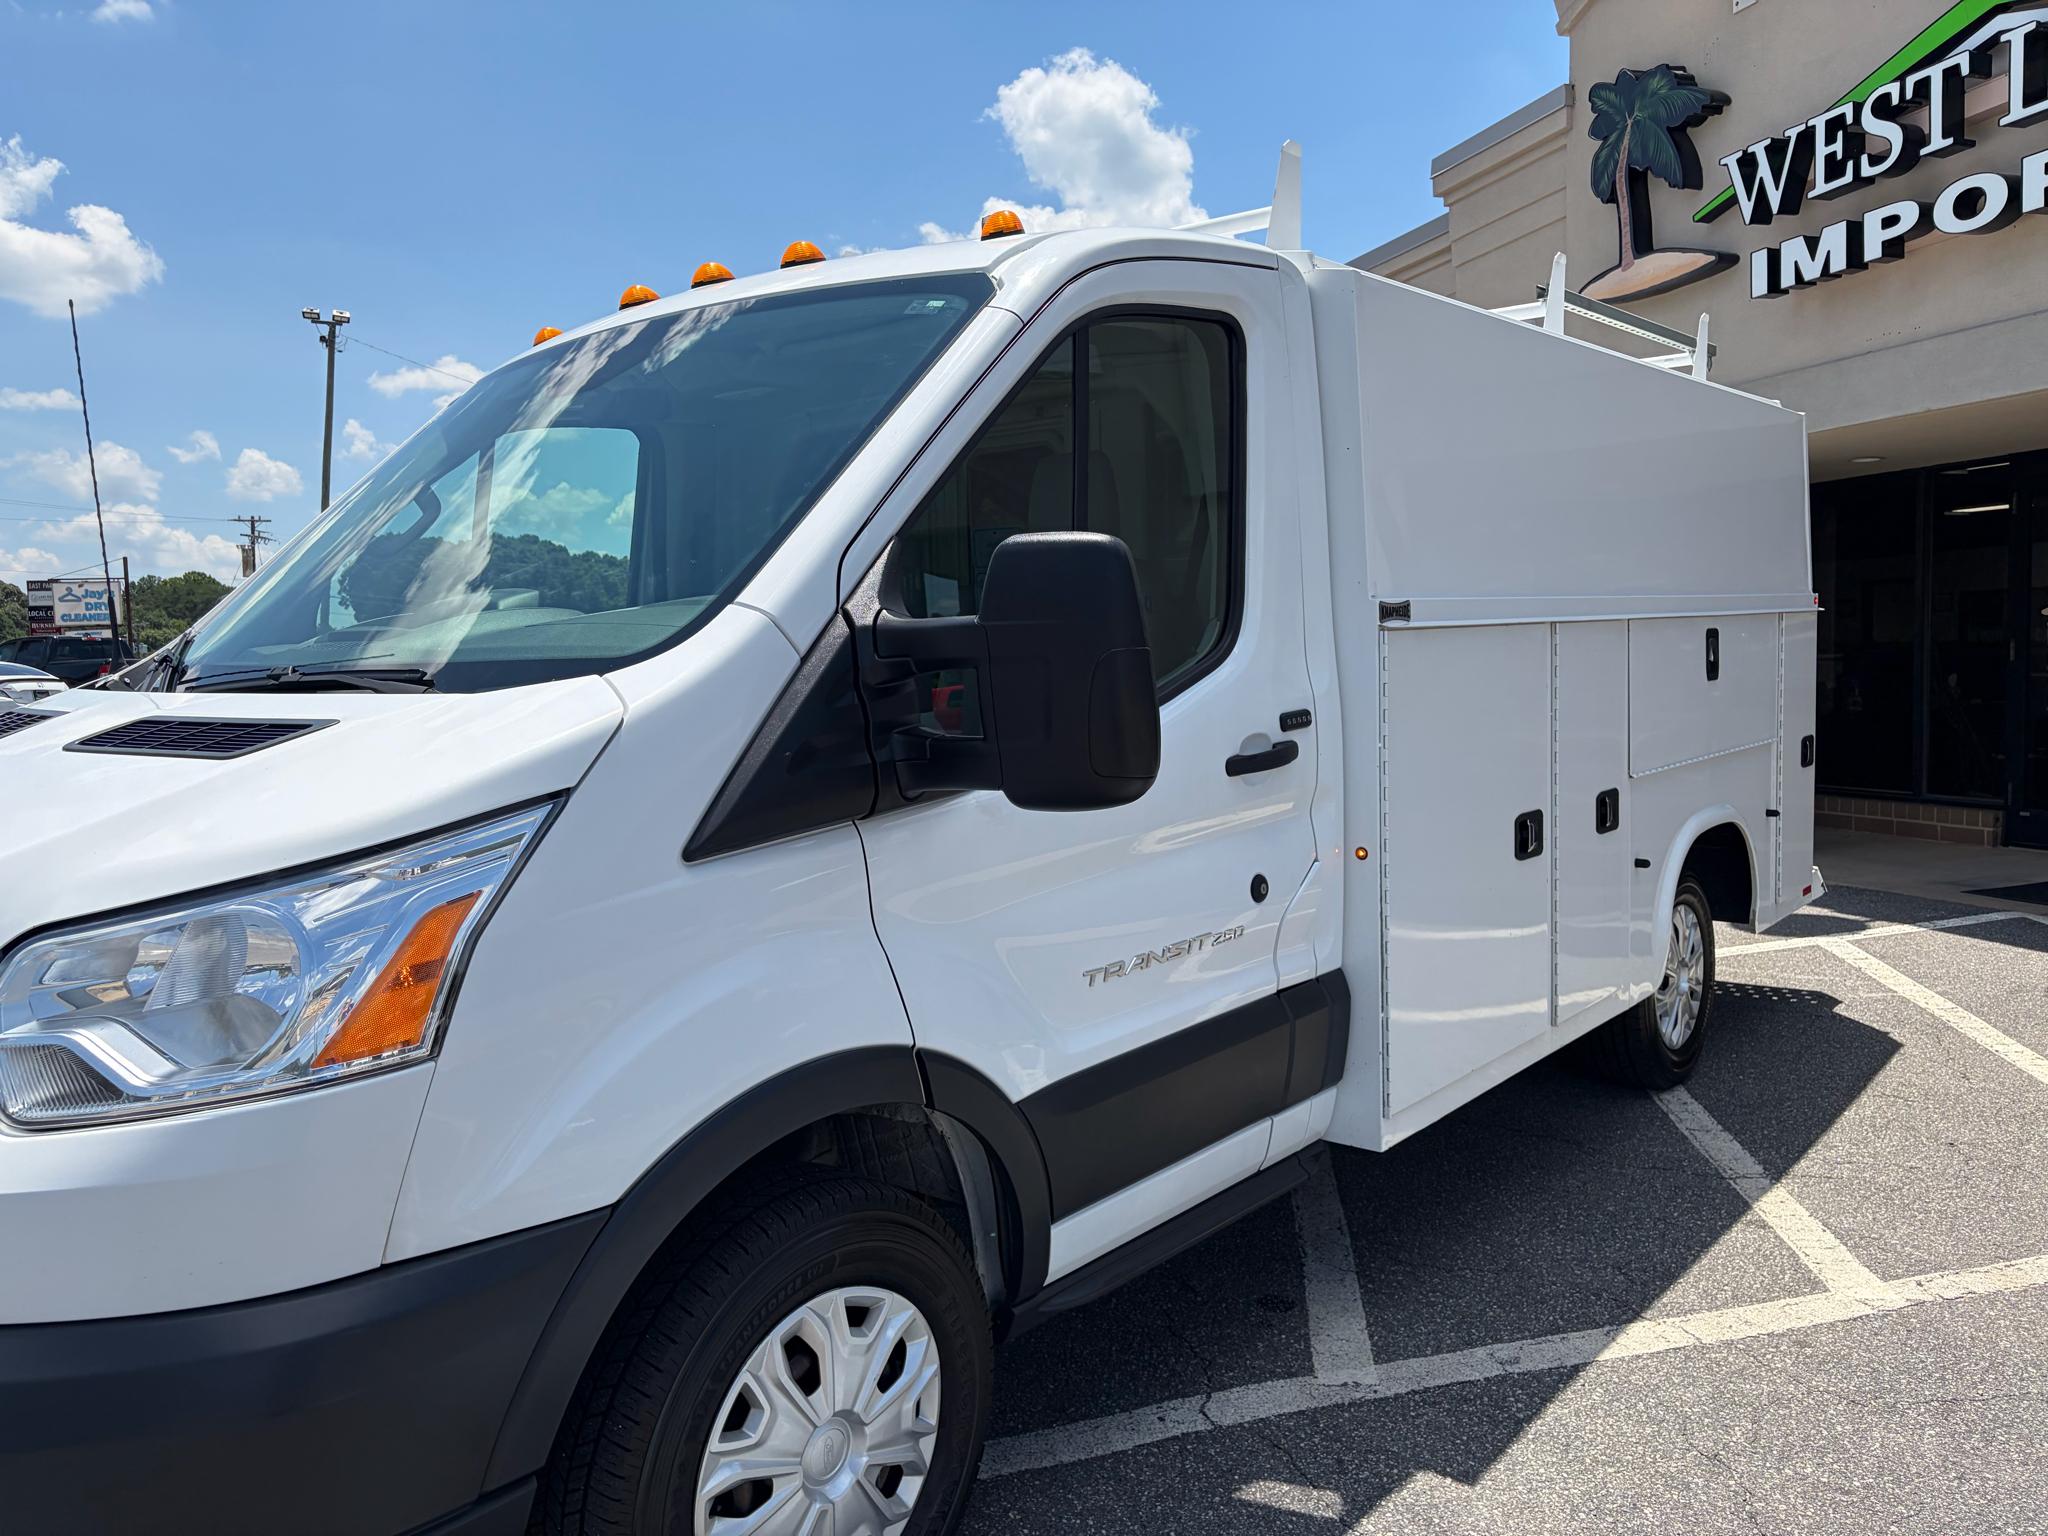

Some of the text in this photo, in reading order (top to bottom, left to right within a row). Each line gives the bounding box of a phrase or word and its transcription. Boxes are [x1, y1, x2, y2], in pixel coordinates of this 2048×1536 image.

[1719, 49, 1971, 227] WEST
[1082, 925, 1245, 988] TRANSIT 250
